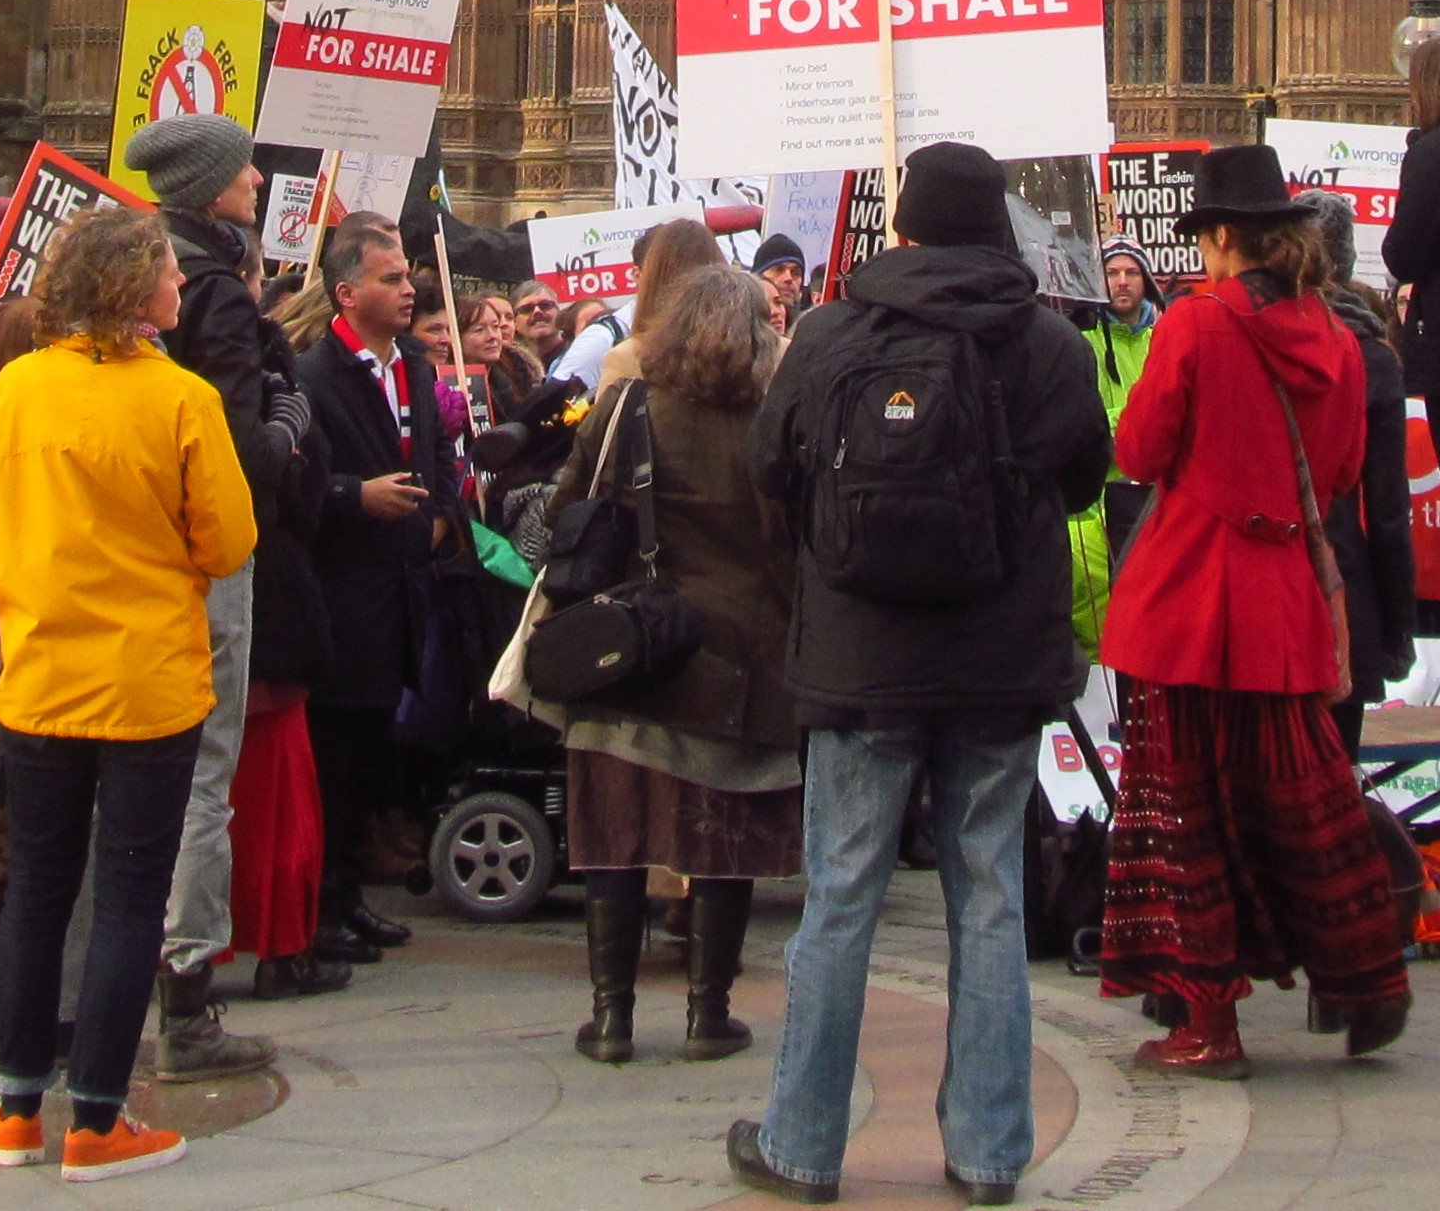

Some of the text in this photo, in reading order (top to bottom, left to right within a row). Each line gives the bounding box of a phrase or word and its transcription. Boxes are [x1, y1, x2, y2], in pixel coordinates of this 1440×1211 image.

[303, 2, 357, 35] NOT
[136, 27, 238, 101] FRACK FREE
[305, 34, 437, 77] FOR SHALE
[785, 62, 828, 74] Two bed
[785, 79, 854, 91] Minor tremors
[785, 97, 846, 109] Underhouse
[848, 96, 866, 107] gas
[786, 115, 835, 126] Previously
[838, 112, 862, 123] quiet
[917, 108, 940, 117] area
[780, 138, 802, 150] Find
[805, 137, 822, 149] out
[825, 137, 851, 148] more
[854, 136, 865, 146] at
[1108, 159, 1148, 186] THE
[1288, 165, 1350, 191] NOT
[32, 169, 87, 226] THE
[1112, 187, 1177, 216] WORD
[555, 249, 605, 276] NOT
[10, 257, 37, 298] A
[567, 272, 617, 296] FOR
